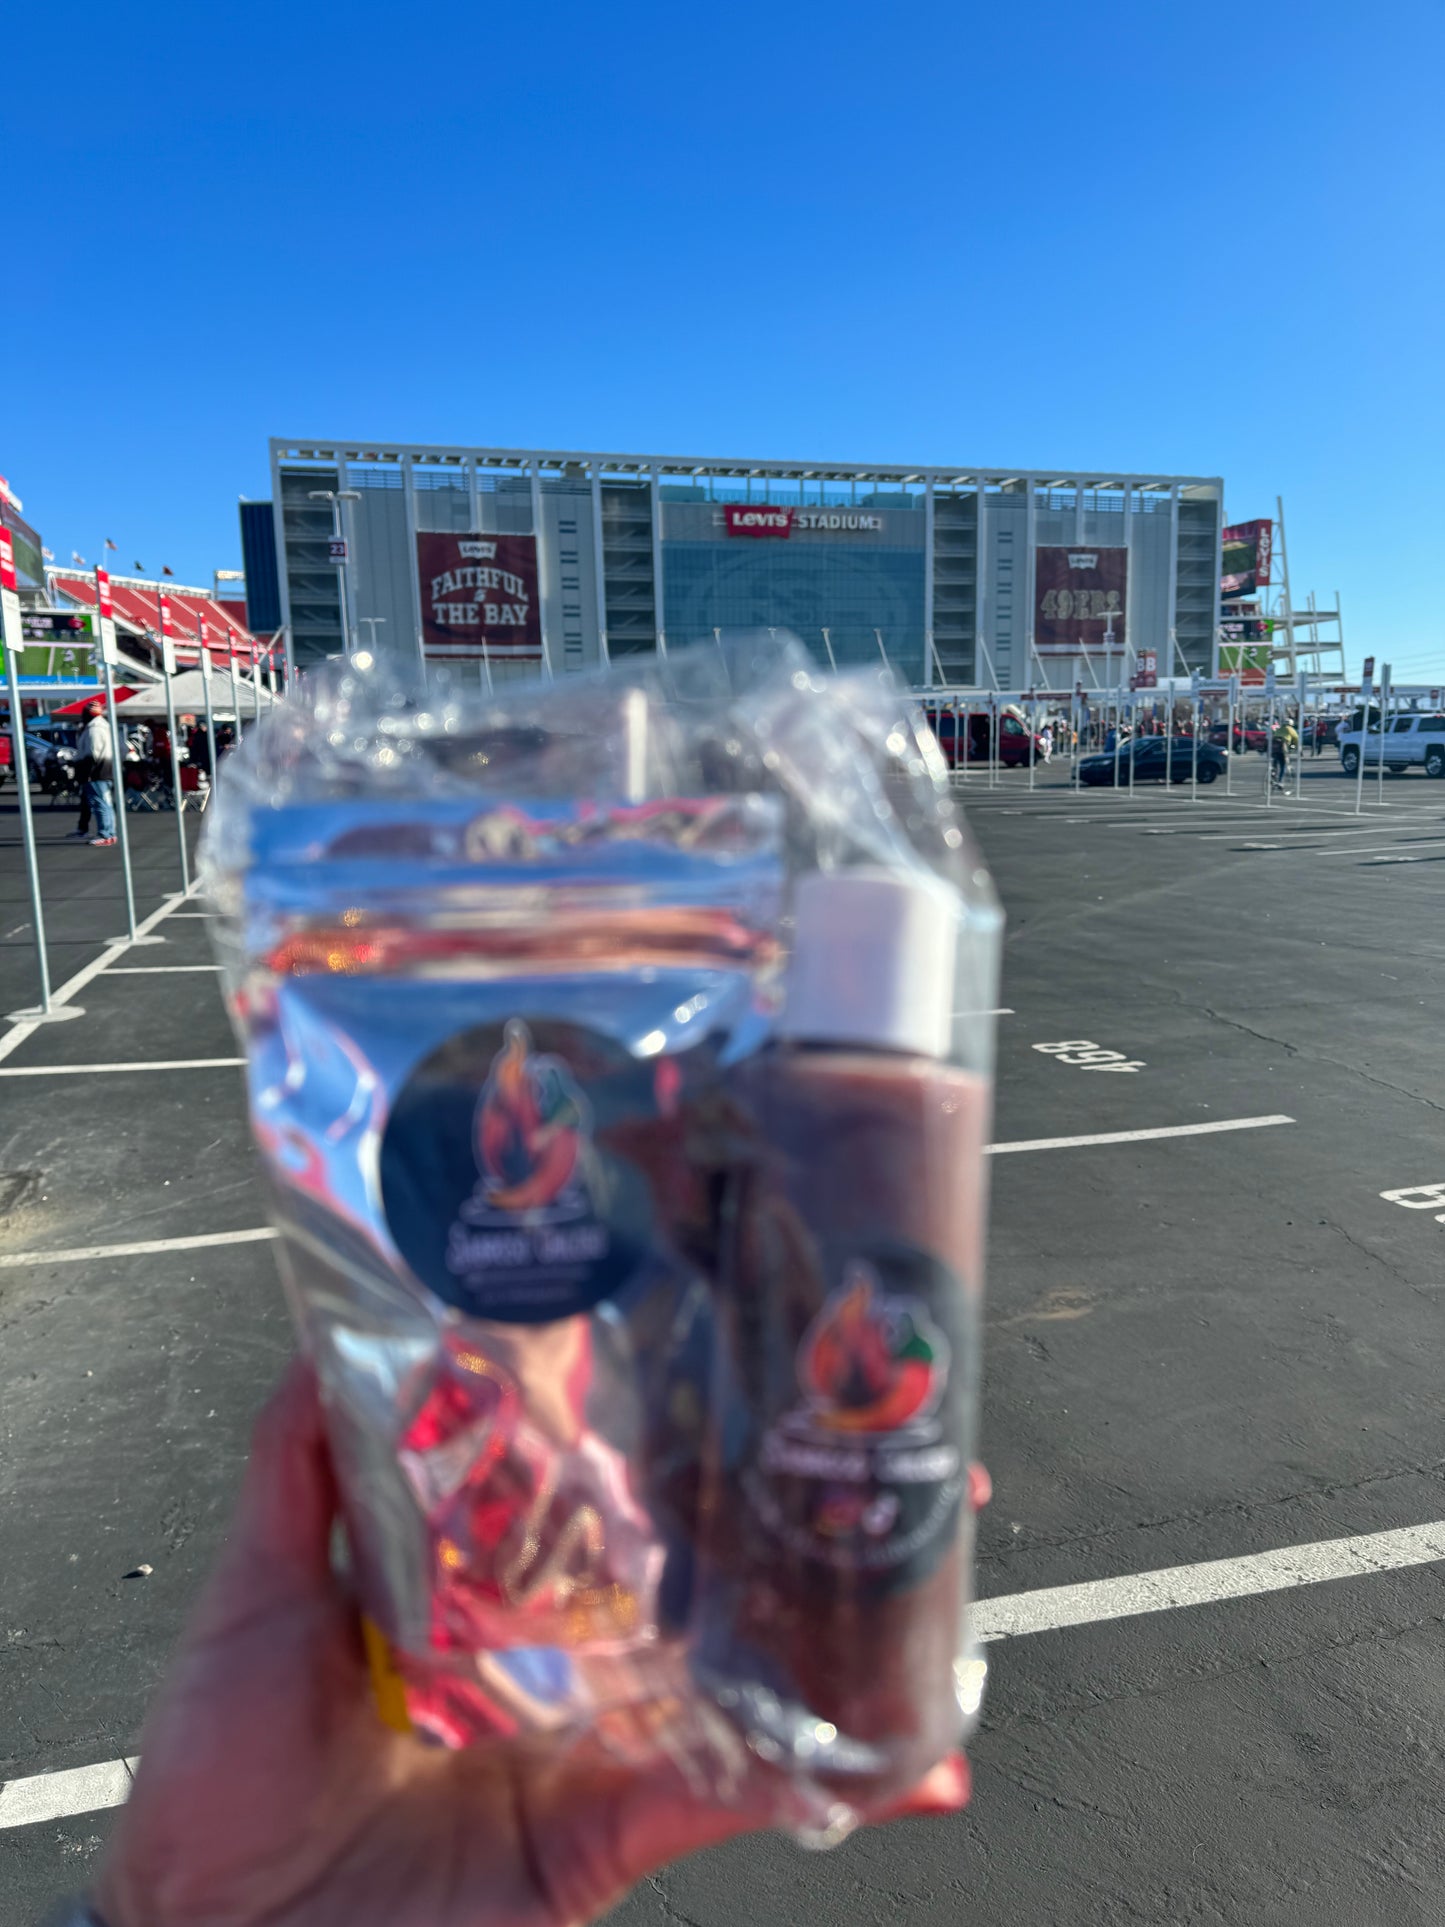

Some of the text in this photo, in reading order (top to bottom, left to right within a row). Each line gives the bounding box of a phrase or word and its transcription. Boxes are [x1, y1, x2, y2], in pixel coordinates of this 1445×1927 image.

[799, 514, 872, 530] STADIUM
[330, 543, 345, 556] 23
[431, 566, 529, 602] FAITHFUL
[432, 602, 530, 626] THE BAY
[1040, 589, 1121, 620] 49ERS
[1031, 1040, 1148, 1073] 468
